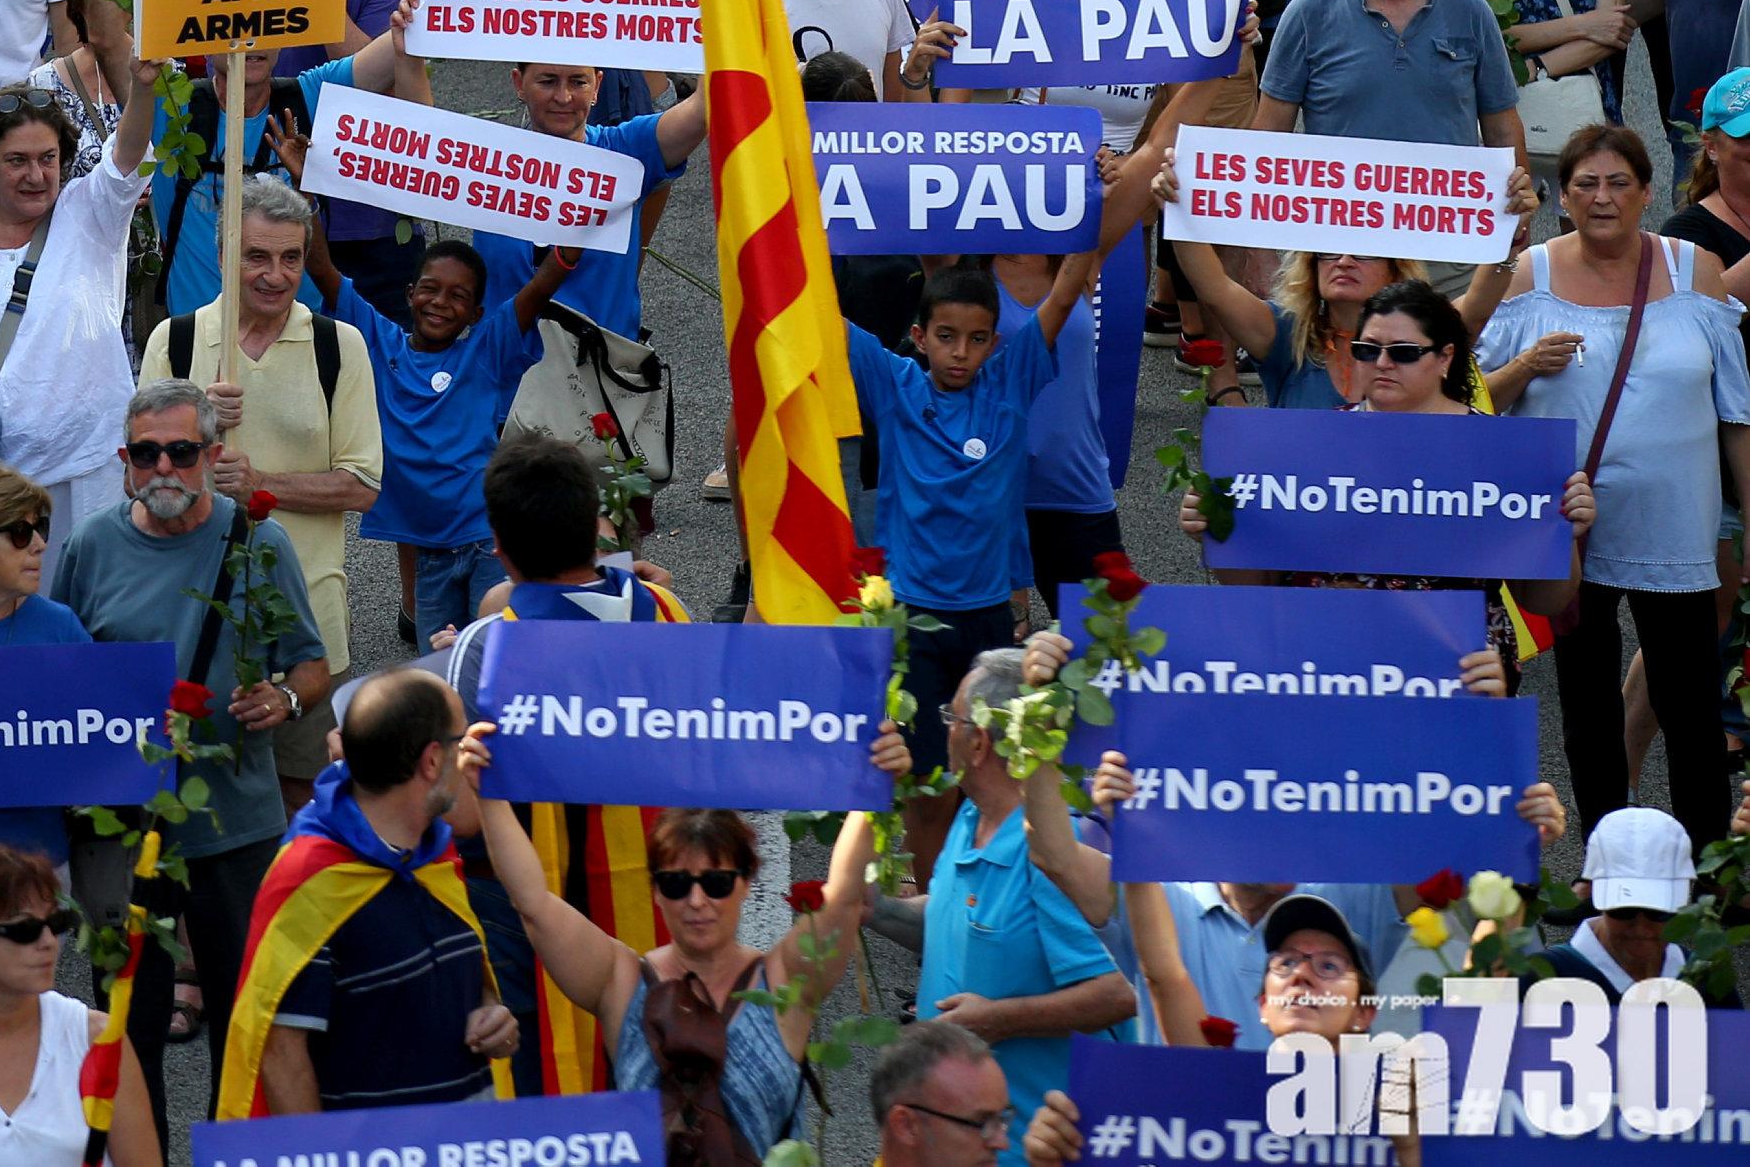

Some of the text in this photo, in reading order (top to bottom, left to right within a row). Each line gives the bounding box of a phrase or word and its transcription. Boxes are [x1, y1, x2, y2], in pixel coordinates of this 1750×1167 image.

[176, 7, 309, 46] ARMES
[427, 6, 474, 33] ELS
[483, 8, 607, 39] NOSTRES
[333, 115, 616, 202] ELS NOSTRES MORTS
[1196, 152, 1493, 202] LES SEVES GUERRES,
[334, 143, 608, 226] LES SEVES GUERRES,
[1191, 189, 1494, 236] ELS NOSTRES MORTS
[1225, 474, 1550, 519] #NoTenimPor
[499, 695, 866, 742] #NoTenimPor
[1124, 767, 1511, 815] #NoTenimPor
